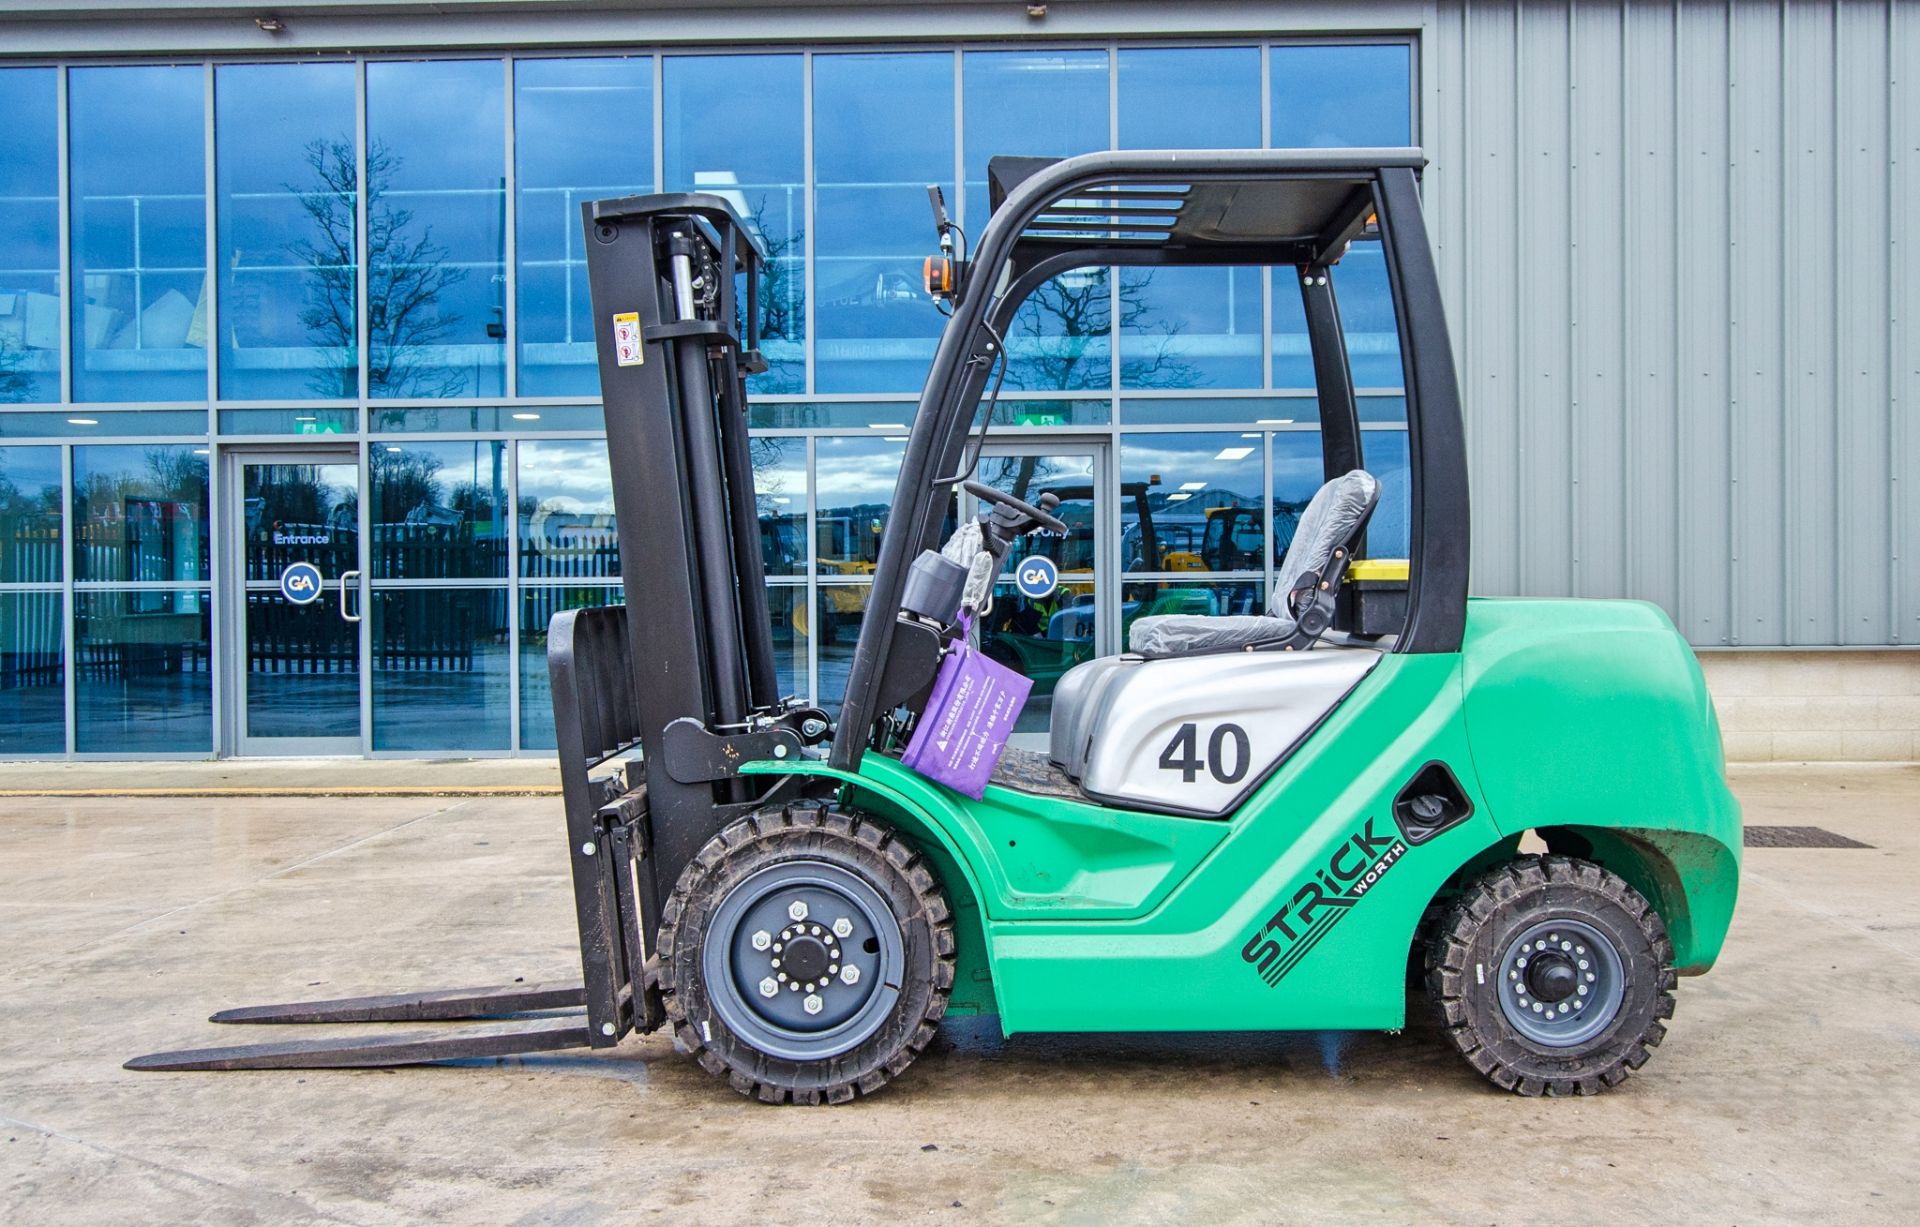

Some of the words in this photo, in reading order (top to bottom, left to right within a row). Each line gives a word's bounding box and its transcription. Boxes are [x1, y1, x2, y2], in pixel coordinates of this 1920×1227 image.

[274, 532, 329, 544] Entrance
[288, 575, 315, 591] GA
[1023, 569, 1051, 585] GA
[1159, 723, 1251, 785] 40
[1353, 843, 1405, 896] WORTH
